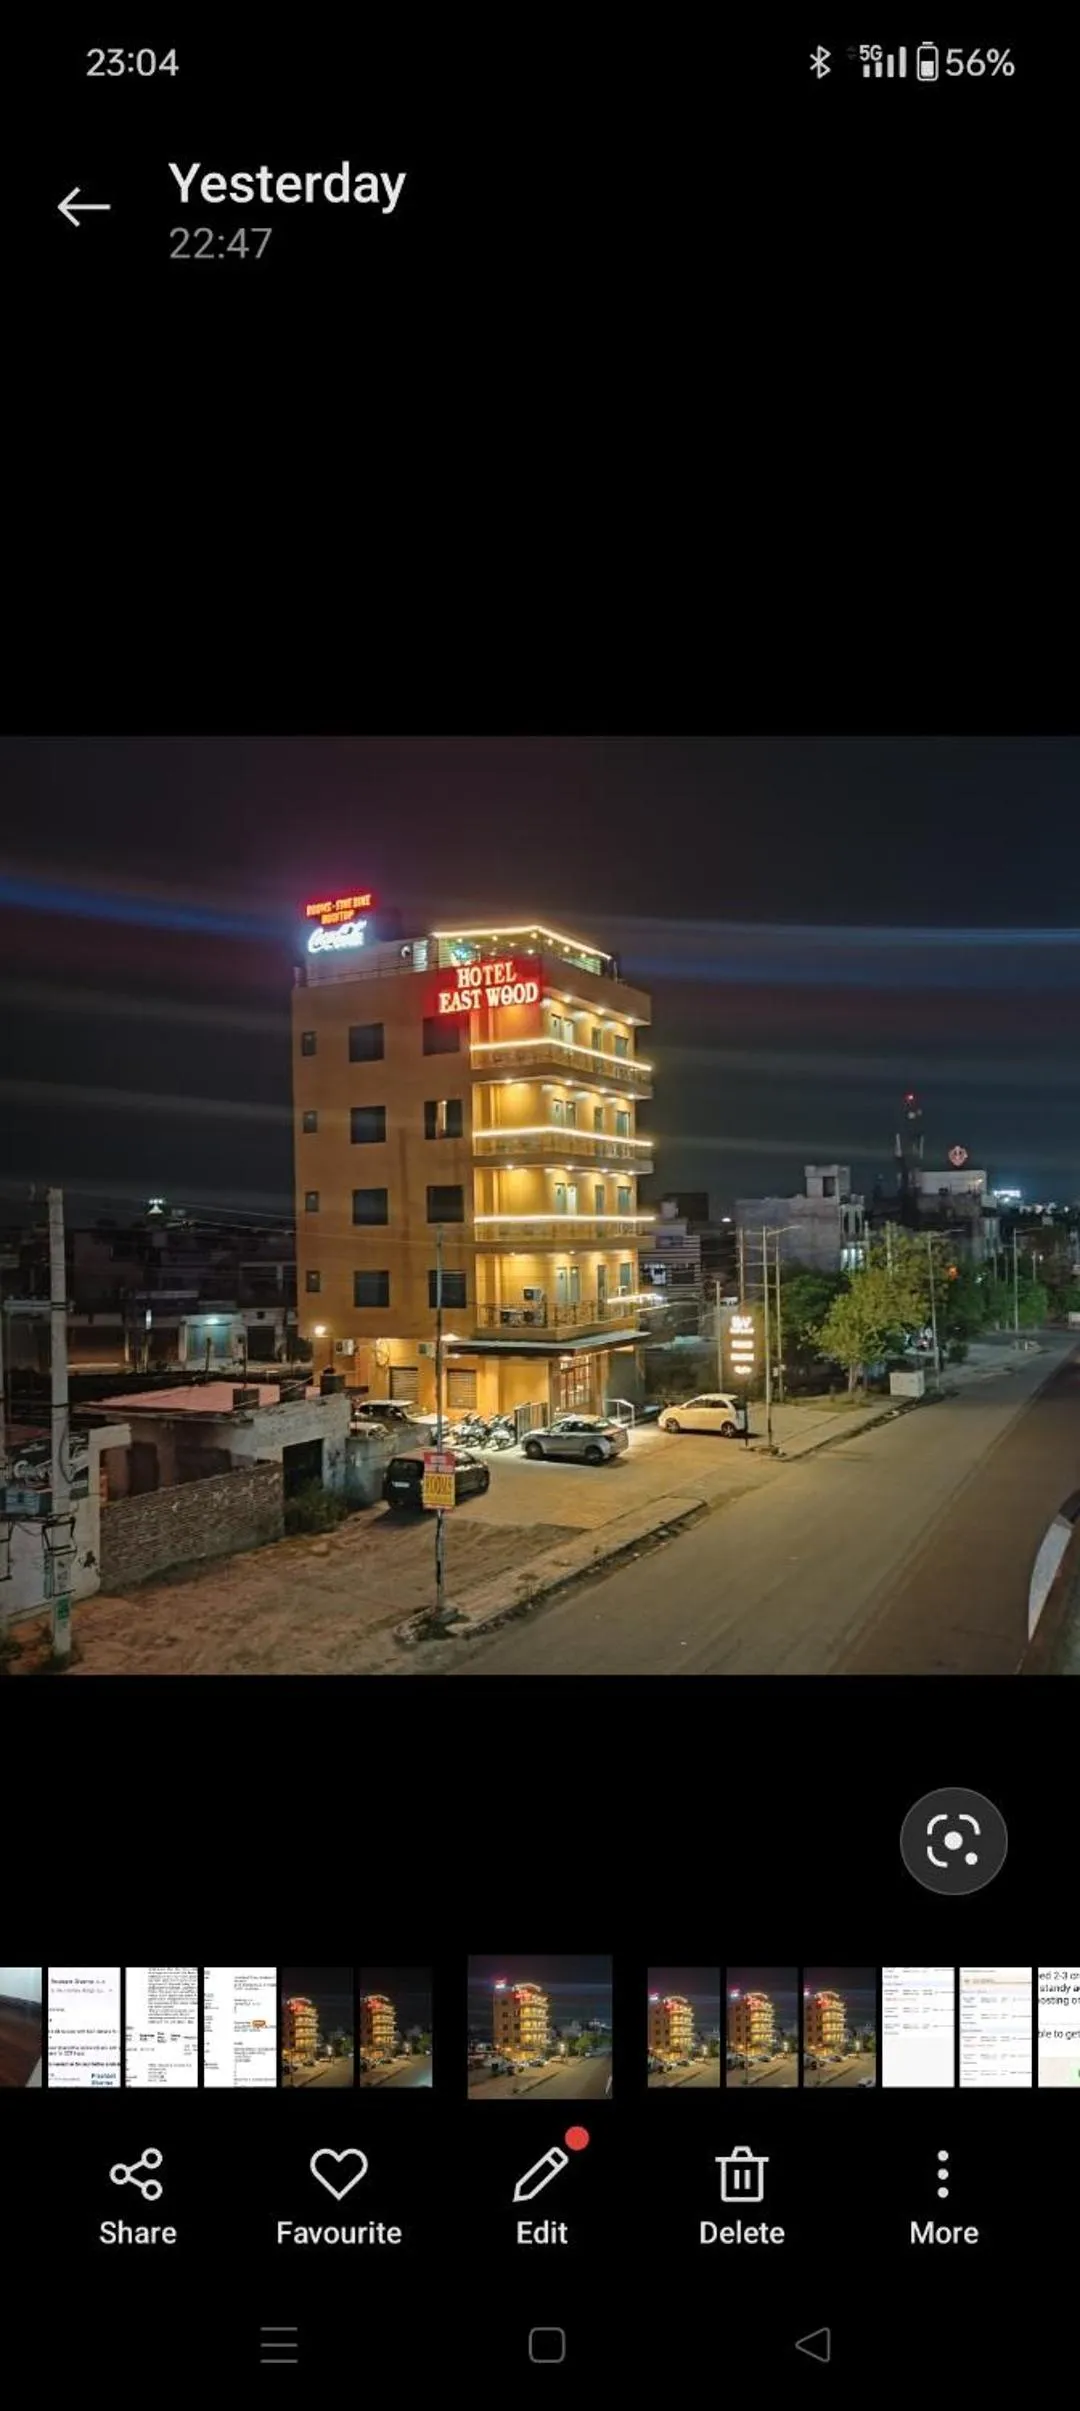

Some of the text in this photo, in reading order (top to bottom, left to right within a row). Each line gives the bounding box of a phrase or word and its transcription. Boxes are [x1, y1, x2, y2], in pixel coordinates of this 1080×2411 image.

[86, 47, 180, 77] 23:04
[860, 44, 883, 61] 5G
[945, 47, 1016, 77] 56%
[168, 160, 408, 215] Yesterday
[169, 227, 273, 259] 22:47
[457, 961, 517, 989] HOTEL
[438, 982, 539, 1014] EAST WOOD
[99, 2220, 178, 2245] Share
[277, 2220, 403, 2245] Favourite
[516, 2219, 569, 2245] Edit
[699, 2219, 786, 2245] Delete
[910, 2220, 980, 2245] More
